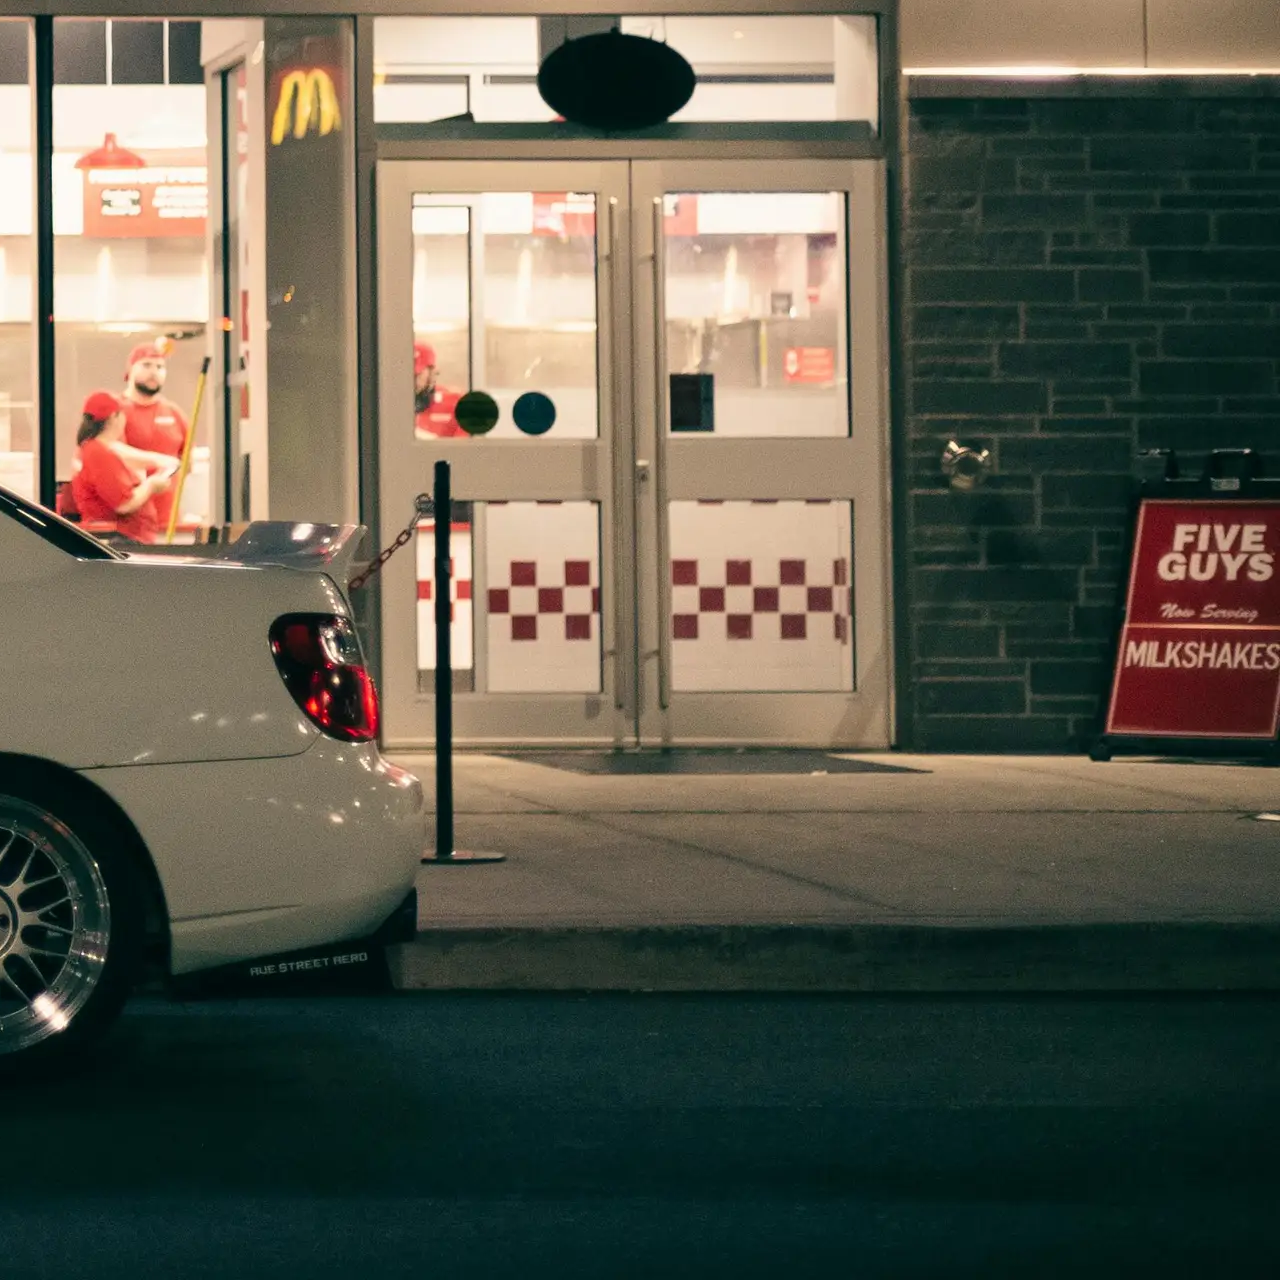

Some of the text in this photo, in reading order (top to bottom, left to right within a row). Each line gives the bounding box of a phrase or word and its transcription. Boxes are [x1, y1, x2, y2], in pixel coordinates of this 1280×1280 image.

[1172, 524, 1267, 552] FIVE
[1157, 552, 1274, 582] GUYS
[1160, 603, 1259, 623] Now Serving
[1125, 640, 1280, 670] MILKSHAKES
[278, 958, 329, 973] STREET
